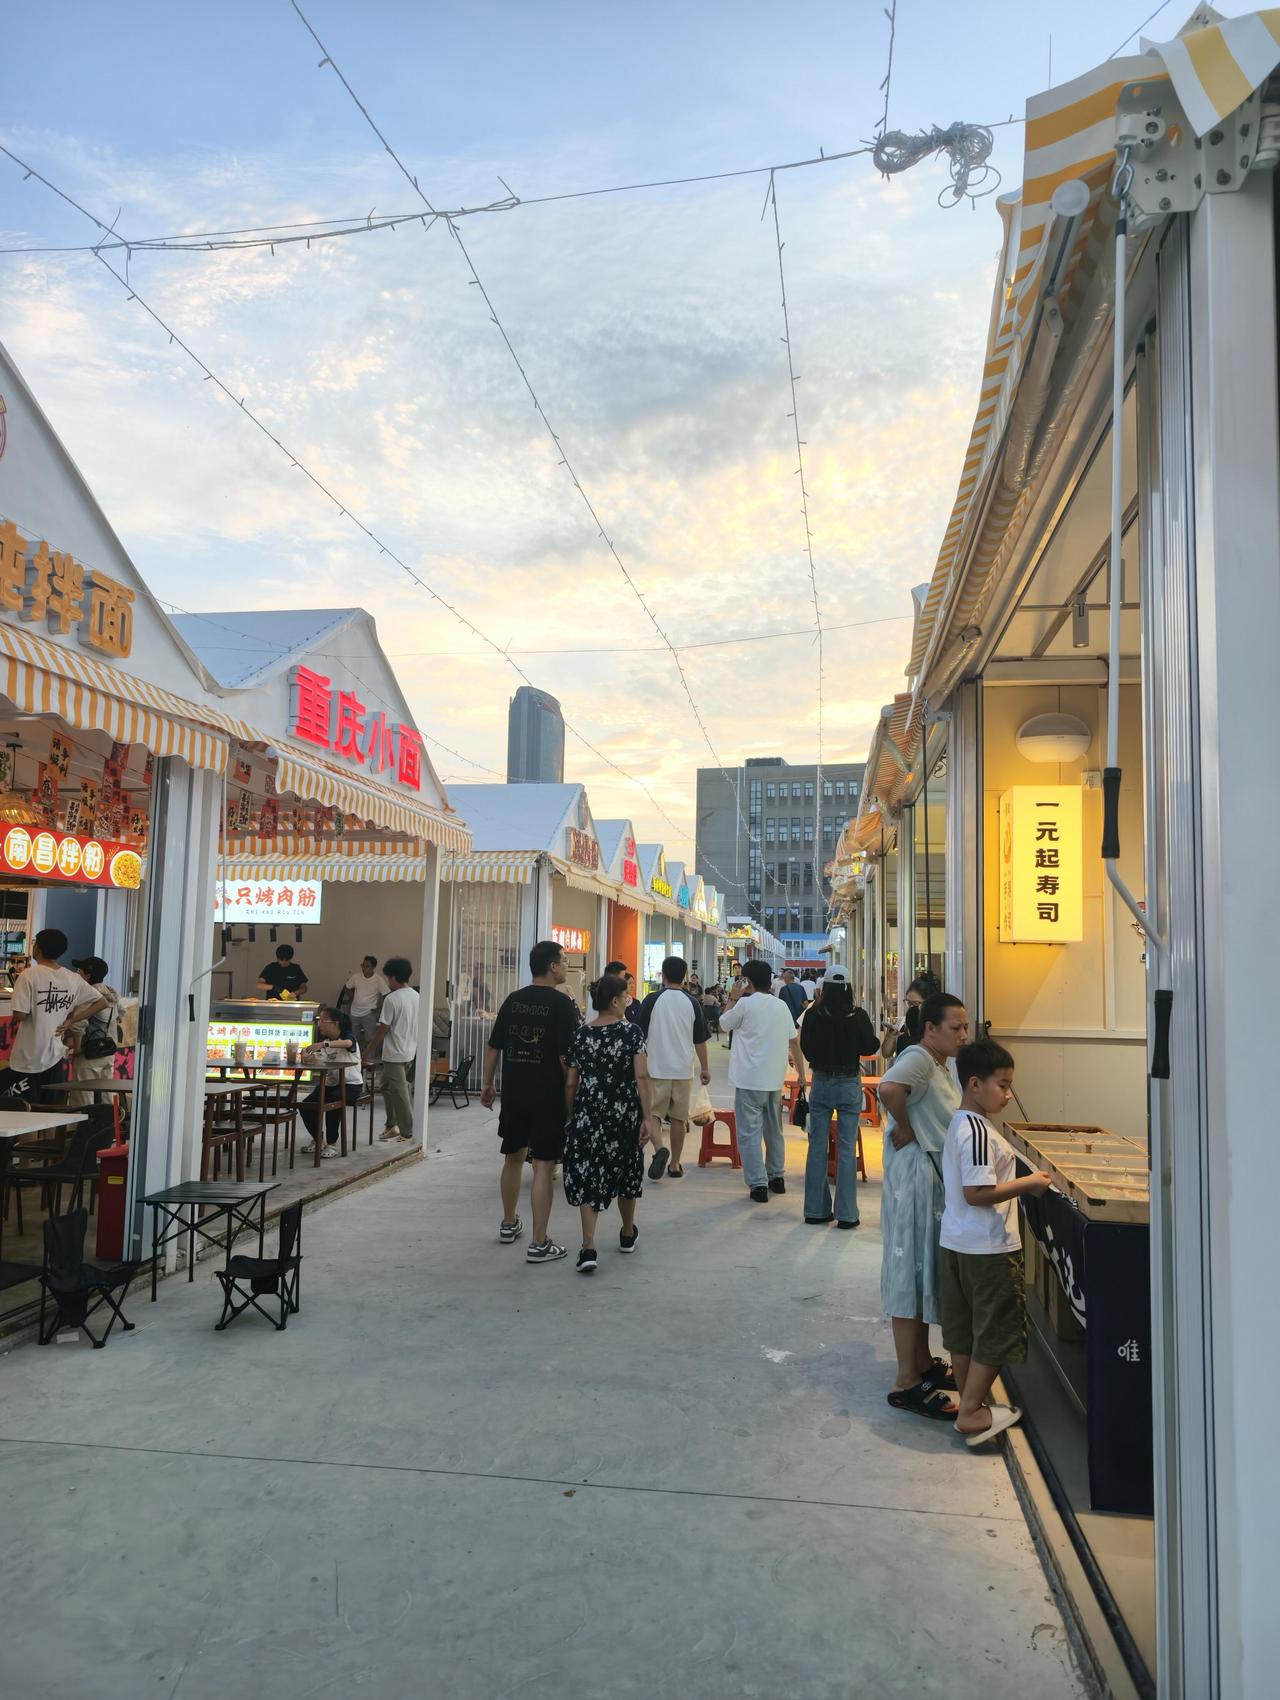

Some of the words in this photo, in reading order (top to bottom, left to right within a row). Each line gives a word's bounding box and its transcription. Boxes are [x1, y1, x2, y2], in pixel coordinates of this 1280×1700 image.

[295, 664, 422, 792] 重庆小面
[8, 832, 102, 873] 南昌拌粉
[1035, 802, 1060, 923] 一元起寿司
